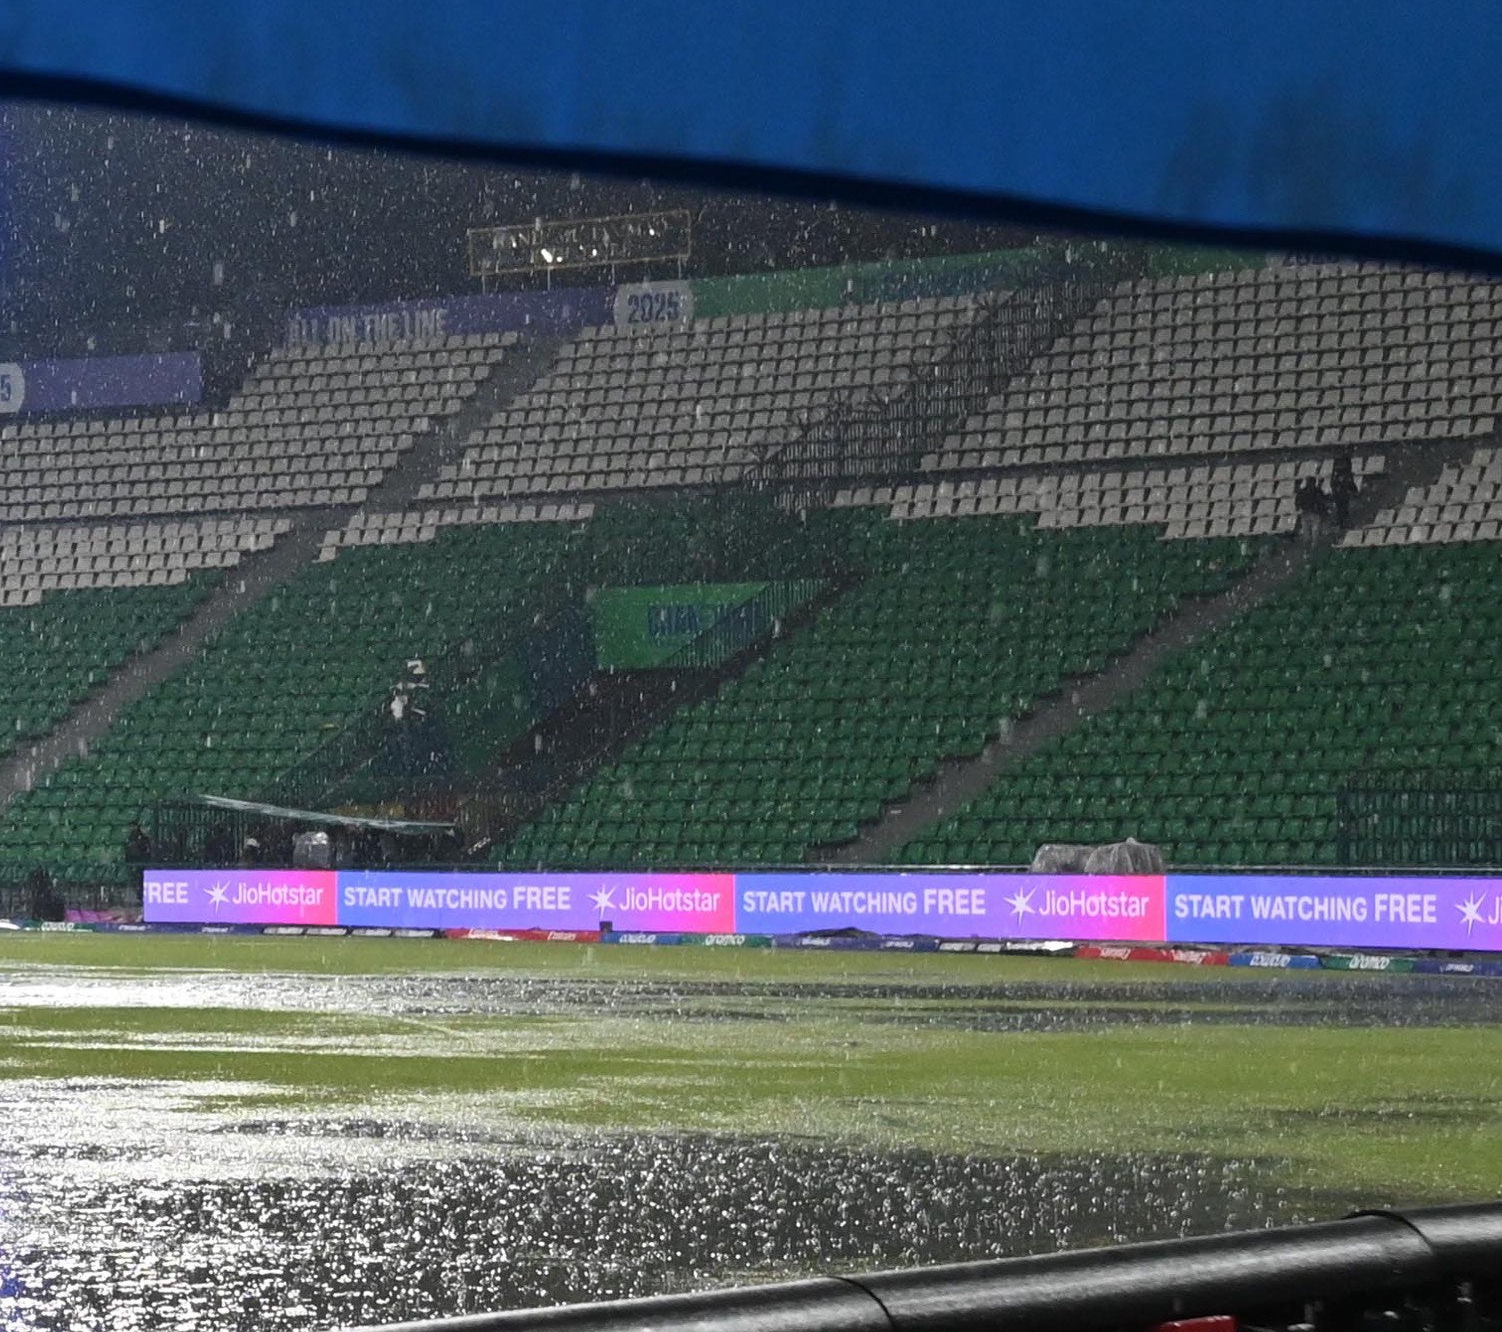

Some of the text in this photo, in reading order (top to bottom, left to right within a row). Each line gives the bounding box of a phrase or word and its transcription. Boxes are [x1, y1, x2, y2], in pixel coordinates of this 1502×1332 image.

[627, 292, 679, 324] 2025
[362, 312, 400, 341] THE
[404, 308, 448, 337] LINE
[144, 882, 324, 906] REE JioHotstar
[344, 885, 721, 912] START WATCHING FREE JioHotstar
[743, 888, 1150, 918] START WATCHING FREE JioHotstar
[1174, 893, 1437, 923] START WATCHING FREE
[705, 934, 745, 946] aramco
